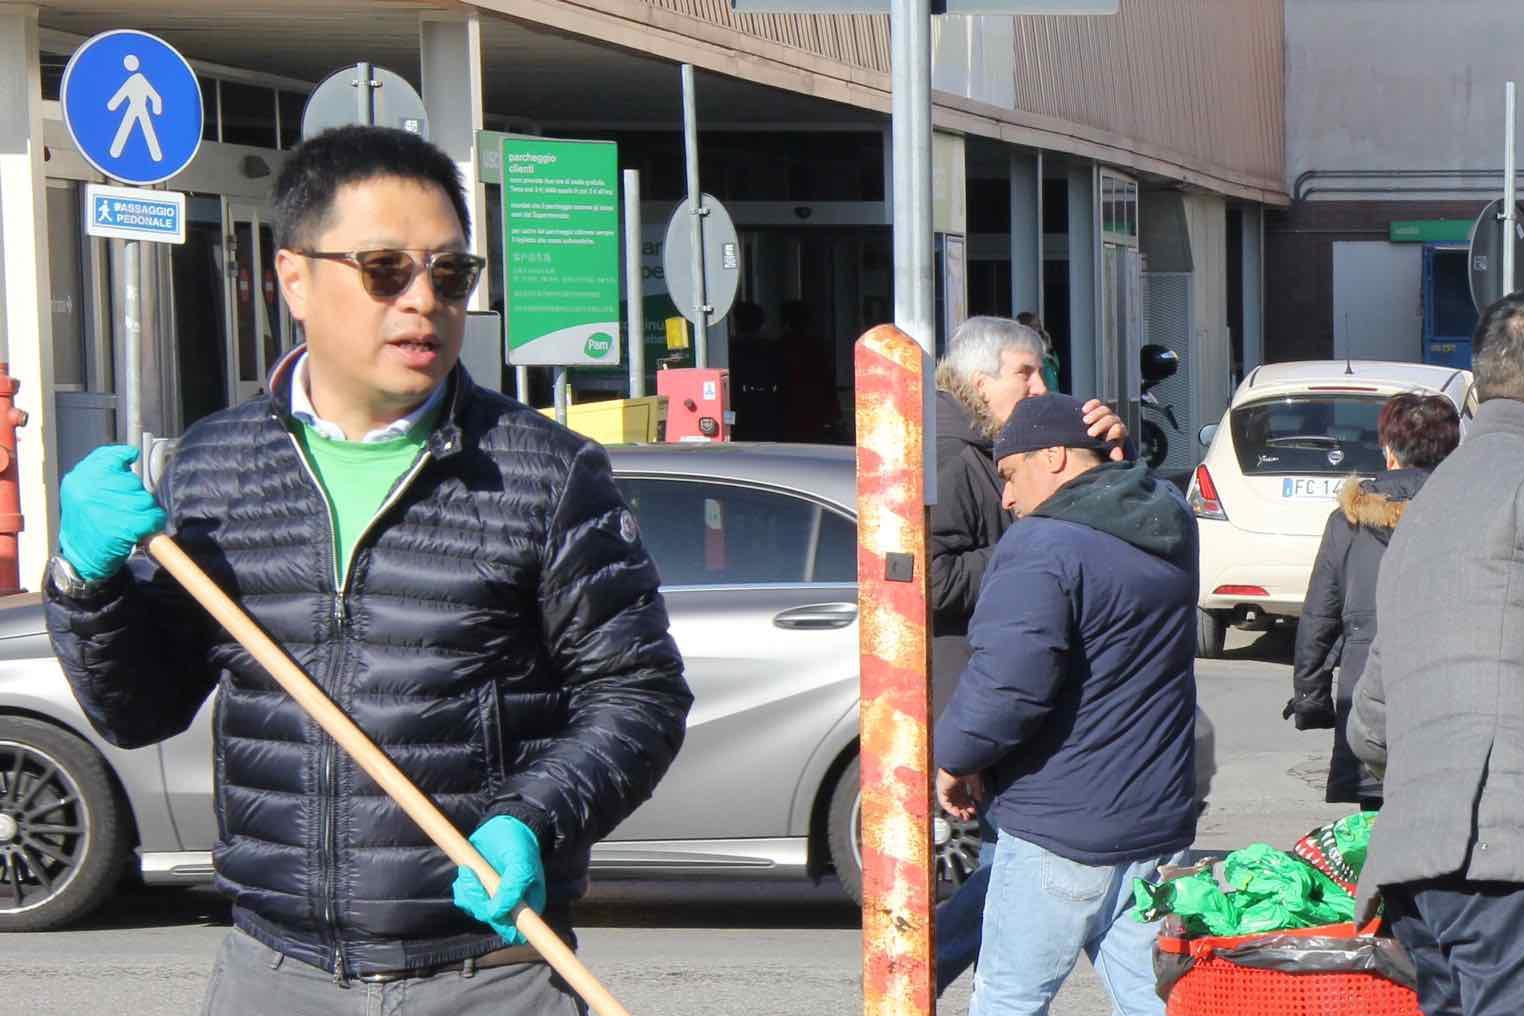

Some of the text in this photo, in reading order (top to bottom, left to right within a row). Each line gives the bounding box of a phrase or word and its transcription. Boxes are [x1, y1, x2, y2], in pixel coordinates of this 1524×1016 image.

[508, 152, 557, 164] parcheggio
[508, 163, 535, 174] clienti
[116, 214, 174, 228] PEDONALE
[588, 339, 609, 352] Pam
